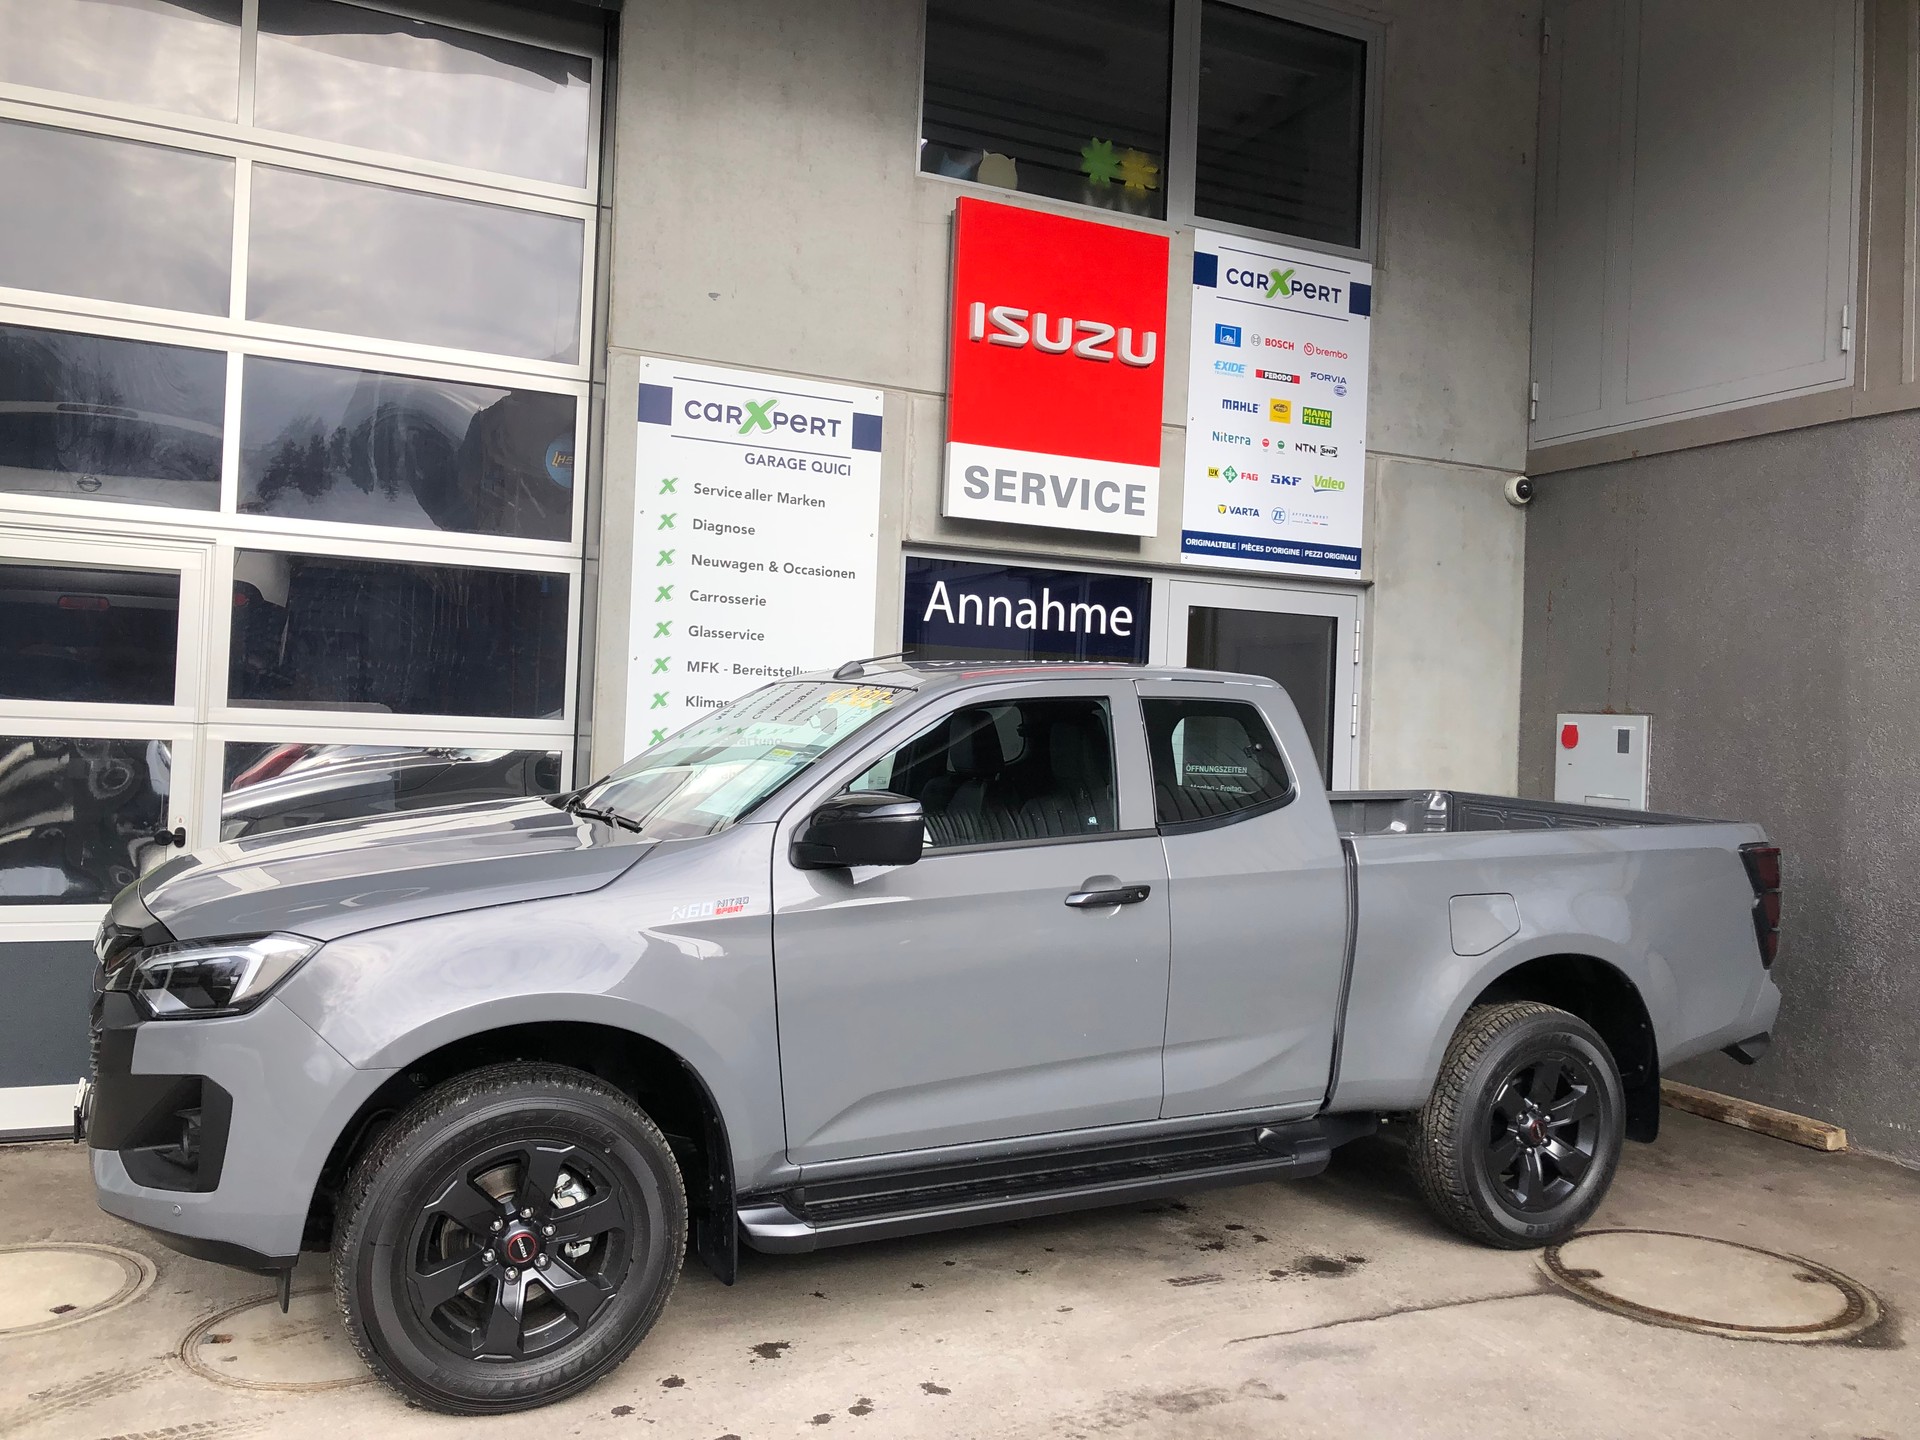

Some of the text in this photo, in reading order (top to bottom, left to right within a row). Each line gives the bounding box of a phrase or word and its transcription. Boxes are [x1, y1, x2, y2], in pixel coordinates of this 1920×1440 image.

[969, 302, 1157, 367] ISUZU
[1265, 338, 1295, 351] BOSCH
[1315, 347, 1348, 359] brembo
[1214, 361, 1246, 374] EXIDE
[1264, 372, 1292, 382] FERODO
[1310, 372, 1347, 384] FORVIA
[1222, 399, 1258, 413] MAHLE
[1304, 408, 1331, 419] MANN
[1303, 415, 1331, 426] FILTER
[1212, 431, 1251, 446] Niterra
[1295, 442, 1317, 453] NTN
[744, 453, 851, 476] GARAGE QUICI
[1241, 472, 1258, 481] FAG
[1270, 474, 1302, 486] SKF
[1313, 474, 1346, 491] Valeo
[694, 483, 826, 508] Service aller Marken
[963, 465, 1146, 517] SERVICE
[1229, 506, 1260, 517] VARTA
[692, 519, 756, 535] Diagnose
[1185, 537, 1357, 562] ORIGINALTEILE PIÈCES D'ORIGINE PEZZI ORIGINALI
[691, 554, 856, 579] Neuwagen & Occasionen
[689, 590, 767, 607] Carrosserie
[923, 580, 1133, 636] Annahme
[688, 625, 765, 641] Glasservice
[687, 661, 720, 674] MFK
[1186, 763, 1248, 774] ÖFFNUNGSZEITEN
